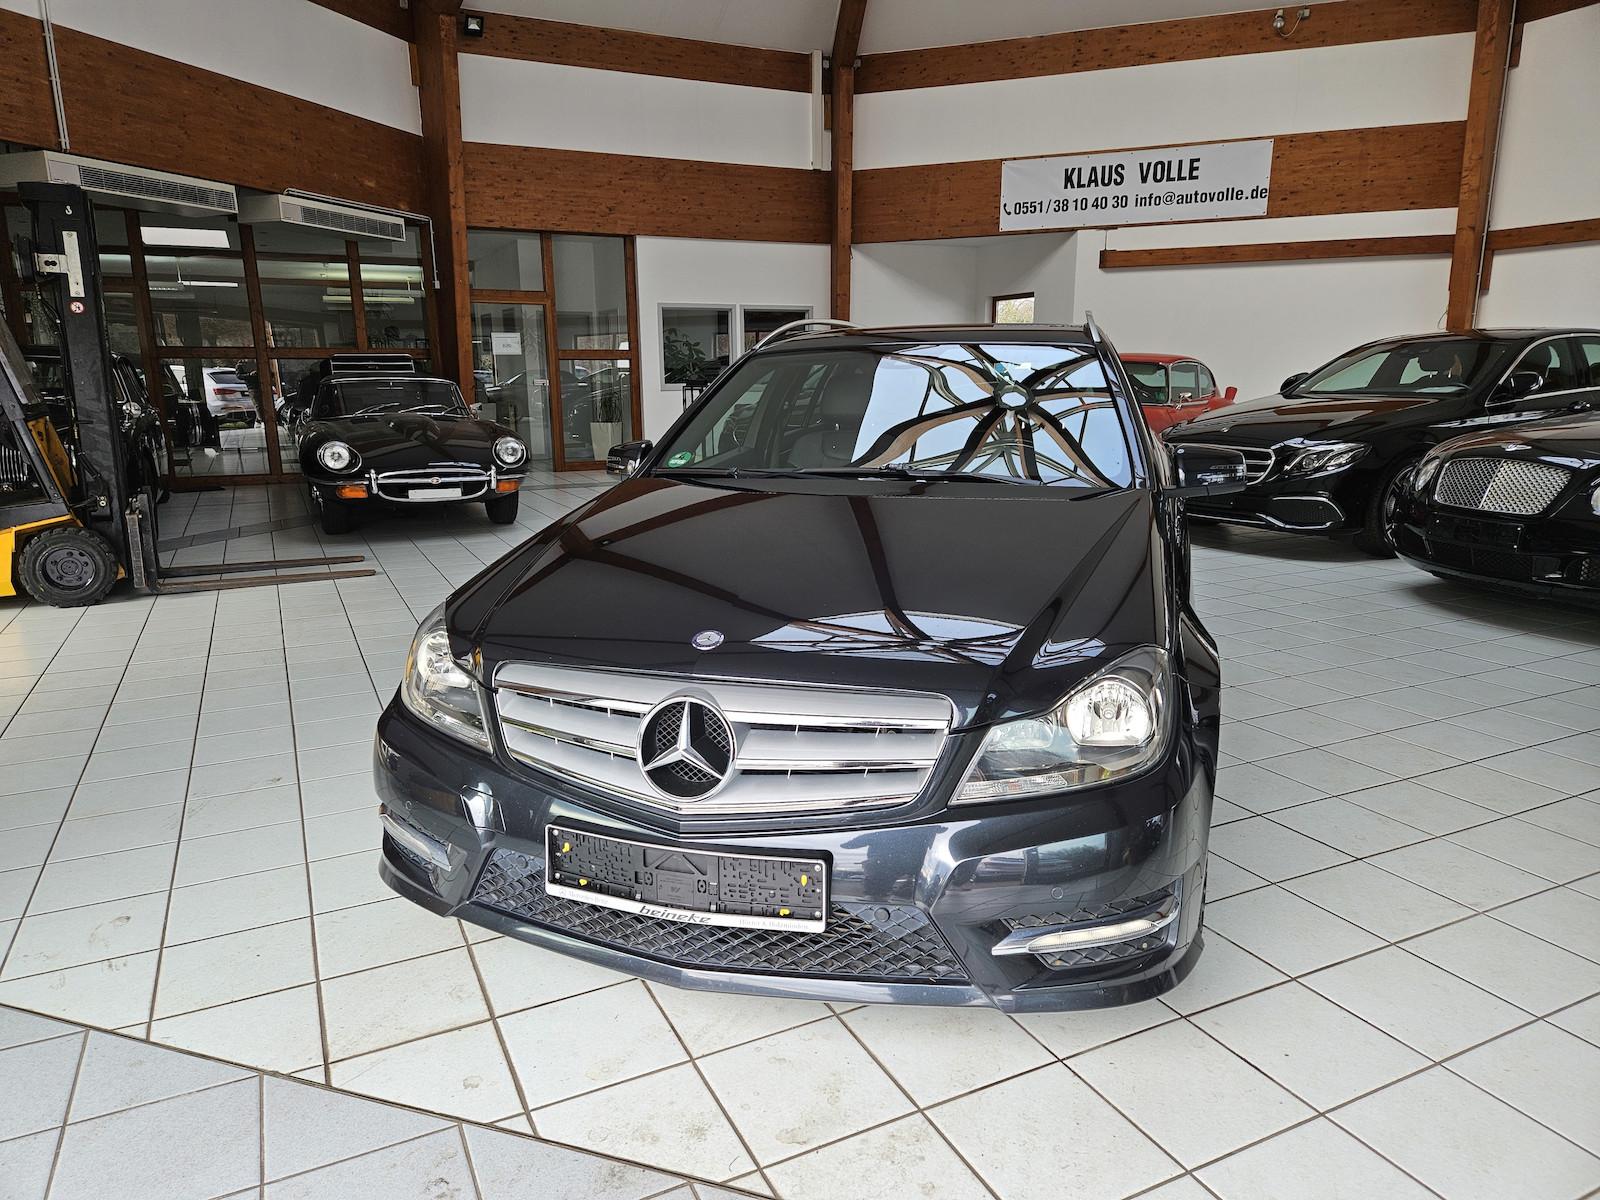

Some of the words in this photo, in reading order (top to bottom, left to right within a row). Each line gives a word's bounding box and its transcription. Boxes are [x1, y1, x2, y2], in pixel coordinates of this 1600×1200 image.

[1063, 164, 1125, 189] KLAUS
[1139, 157, 1201, 184] VOLLE
[1073, 197, 1088, 211] 10
[1091, 196, 1108, 209] 40
[1112, 195, 1128, 208] 30
[1134, 185, 1269, 208] info@autovolle.de
